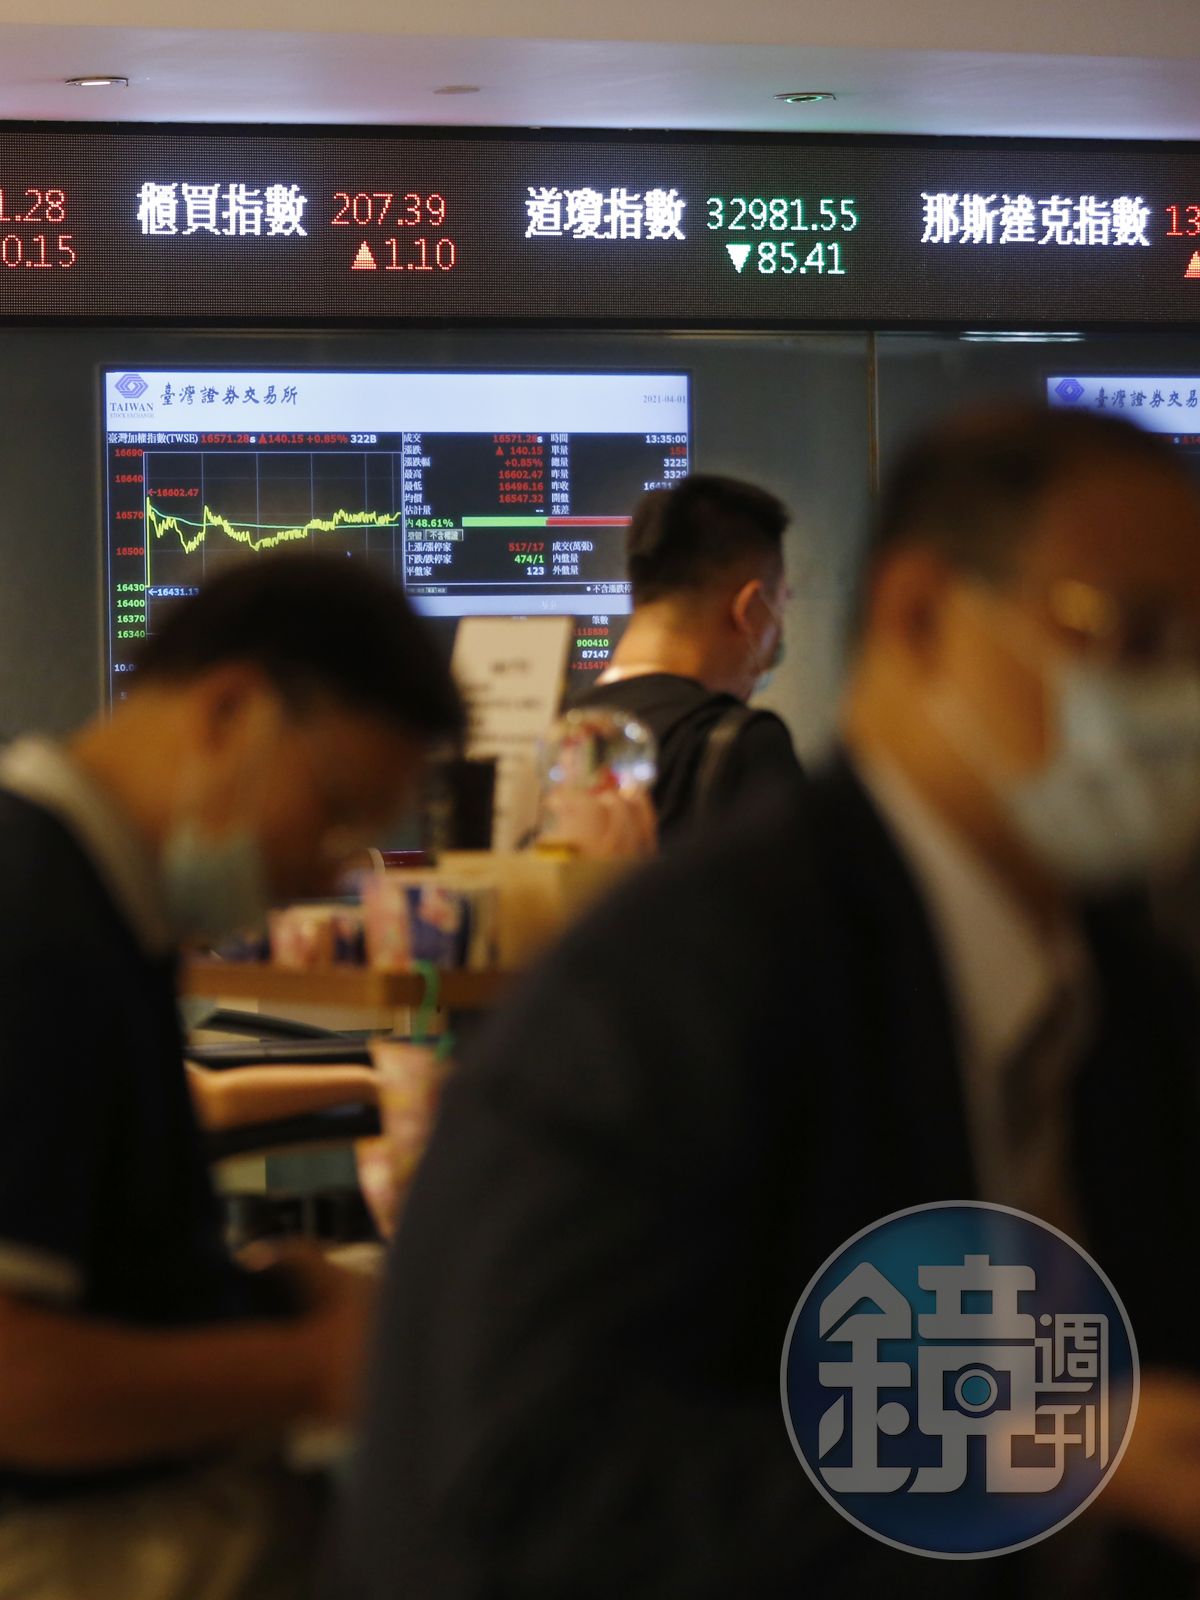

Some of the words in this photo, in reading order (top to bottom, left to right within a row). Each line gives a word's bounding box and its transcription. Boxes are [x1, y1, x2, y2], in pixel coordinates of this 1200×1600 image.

[137, 183, 308, 237] 櫃買指數
[330, 192, 447, 226] 207.39
[525, 186, 686, 239] 道瓊指數
[706, 197, 858, 231] 32981.55
[920, 191, 1151, 246] 那斯達克指數
[385, 238, 456, 271] 1.10
[757, 243, 845, 275] 85.41
[160, 382, 299, 406] 臺灣證券交易所
[110, 402, 154, 411] TAIWAN
[268, 435, 304, 443] 140.15
[350, 434, 377, 444] 322B
[403, 433, 422, 444] 成交
[550, 433, 569, 444] 時間
[645, 434, 687, 444] 13:35:00
[510, 446, 543, 455] 140.15
[663, 458, 687, 467] 3225
[415, 518, 454, 528] 48.61%
[514, 554, 544, 564] 474/1
[526, 566, 545, 576] 123
[116, 584, 145, 592] 16430
[117, 599, 145, 608] 16400
[117, 615, 146, 623] 16370
[117, 630, 146, 639] 16340
[576, 639, 609, 648] 900410
[582, 650, 609, 659] 87147
